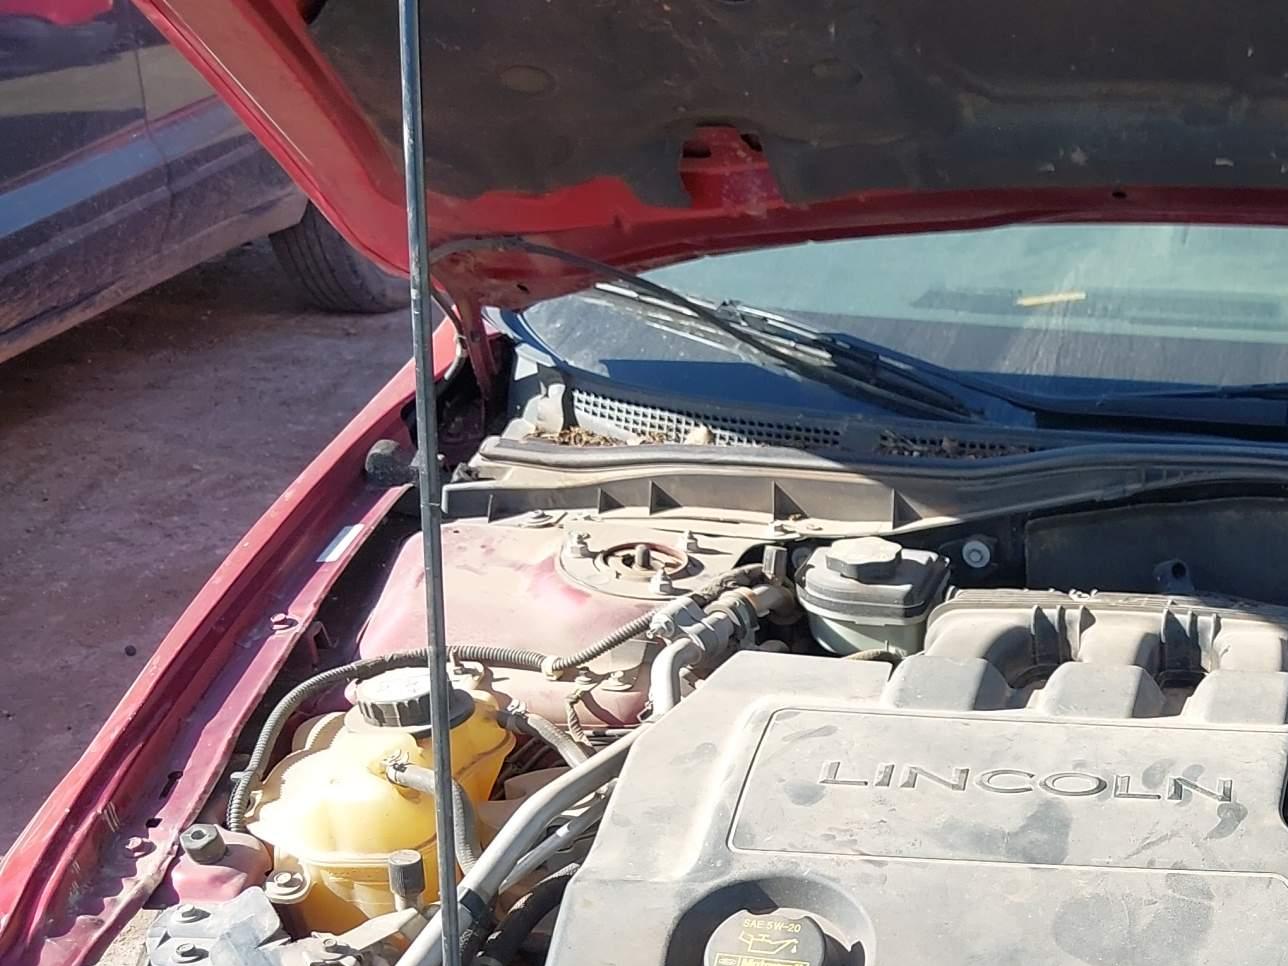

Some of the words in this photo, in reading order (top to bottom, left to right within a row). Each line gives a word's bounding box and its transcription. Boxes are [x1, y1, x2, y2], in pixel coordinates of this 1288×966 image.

[820, 762, 1233, 803] LINCOLN
[744, 919, 763, 929] SAE
[767, 921, 801, 933] 5W-20
